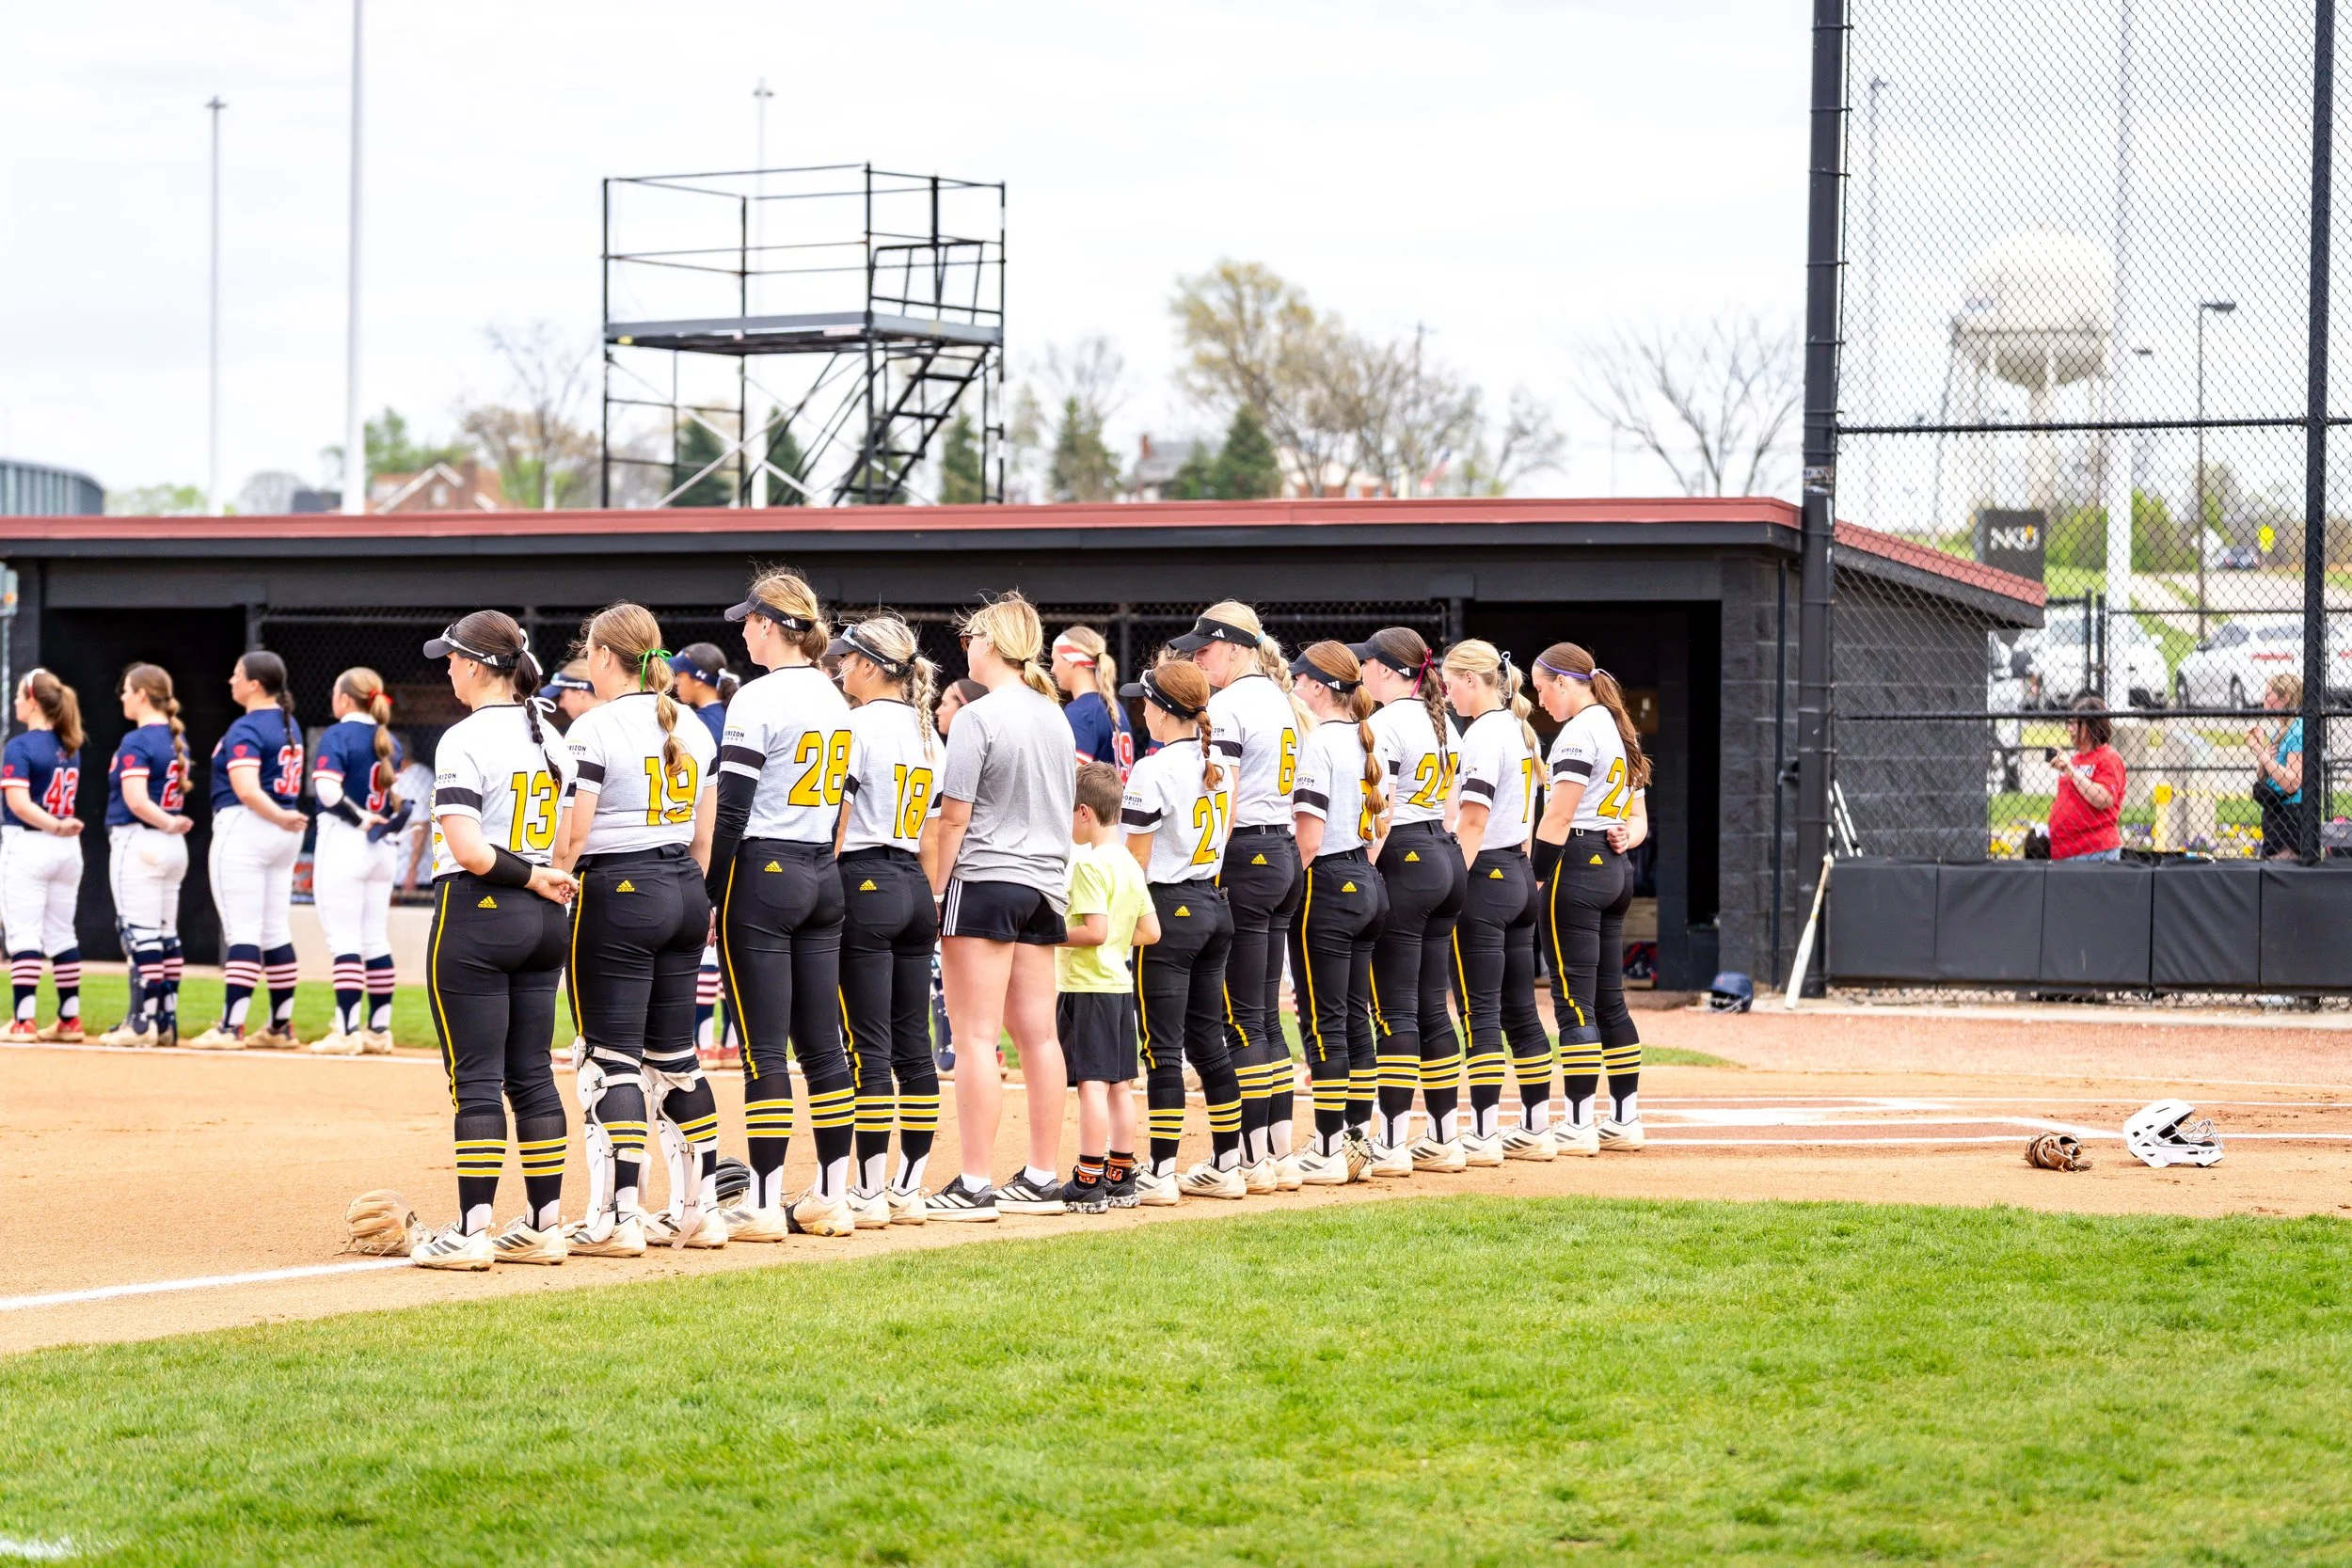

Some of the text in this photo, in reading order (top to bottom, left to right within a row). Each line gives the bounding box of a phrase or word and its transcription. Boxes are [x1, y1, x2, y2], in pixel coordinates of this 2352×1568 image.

[724, 730, 745, 738] ORIZON
[787, 729, 851, 807] 28
[1278, 727, 1296, 797] 6
[42, 767, 79, 816] 42
[509, 770, 562, 852] 13
[644, 754, 698, 826] 19
[894, 764, 932, 839] 18
[1189, 791, 1228, 866] 21
